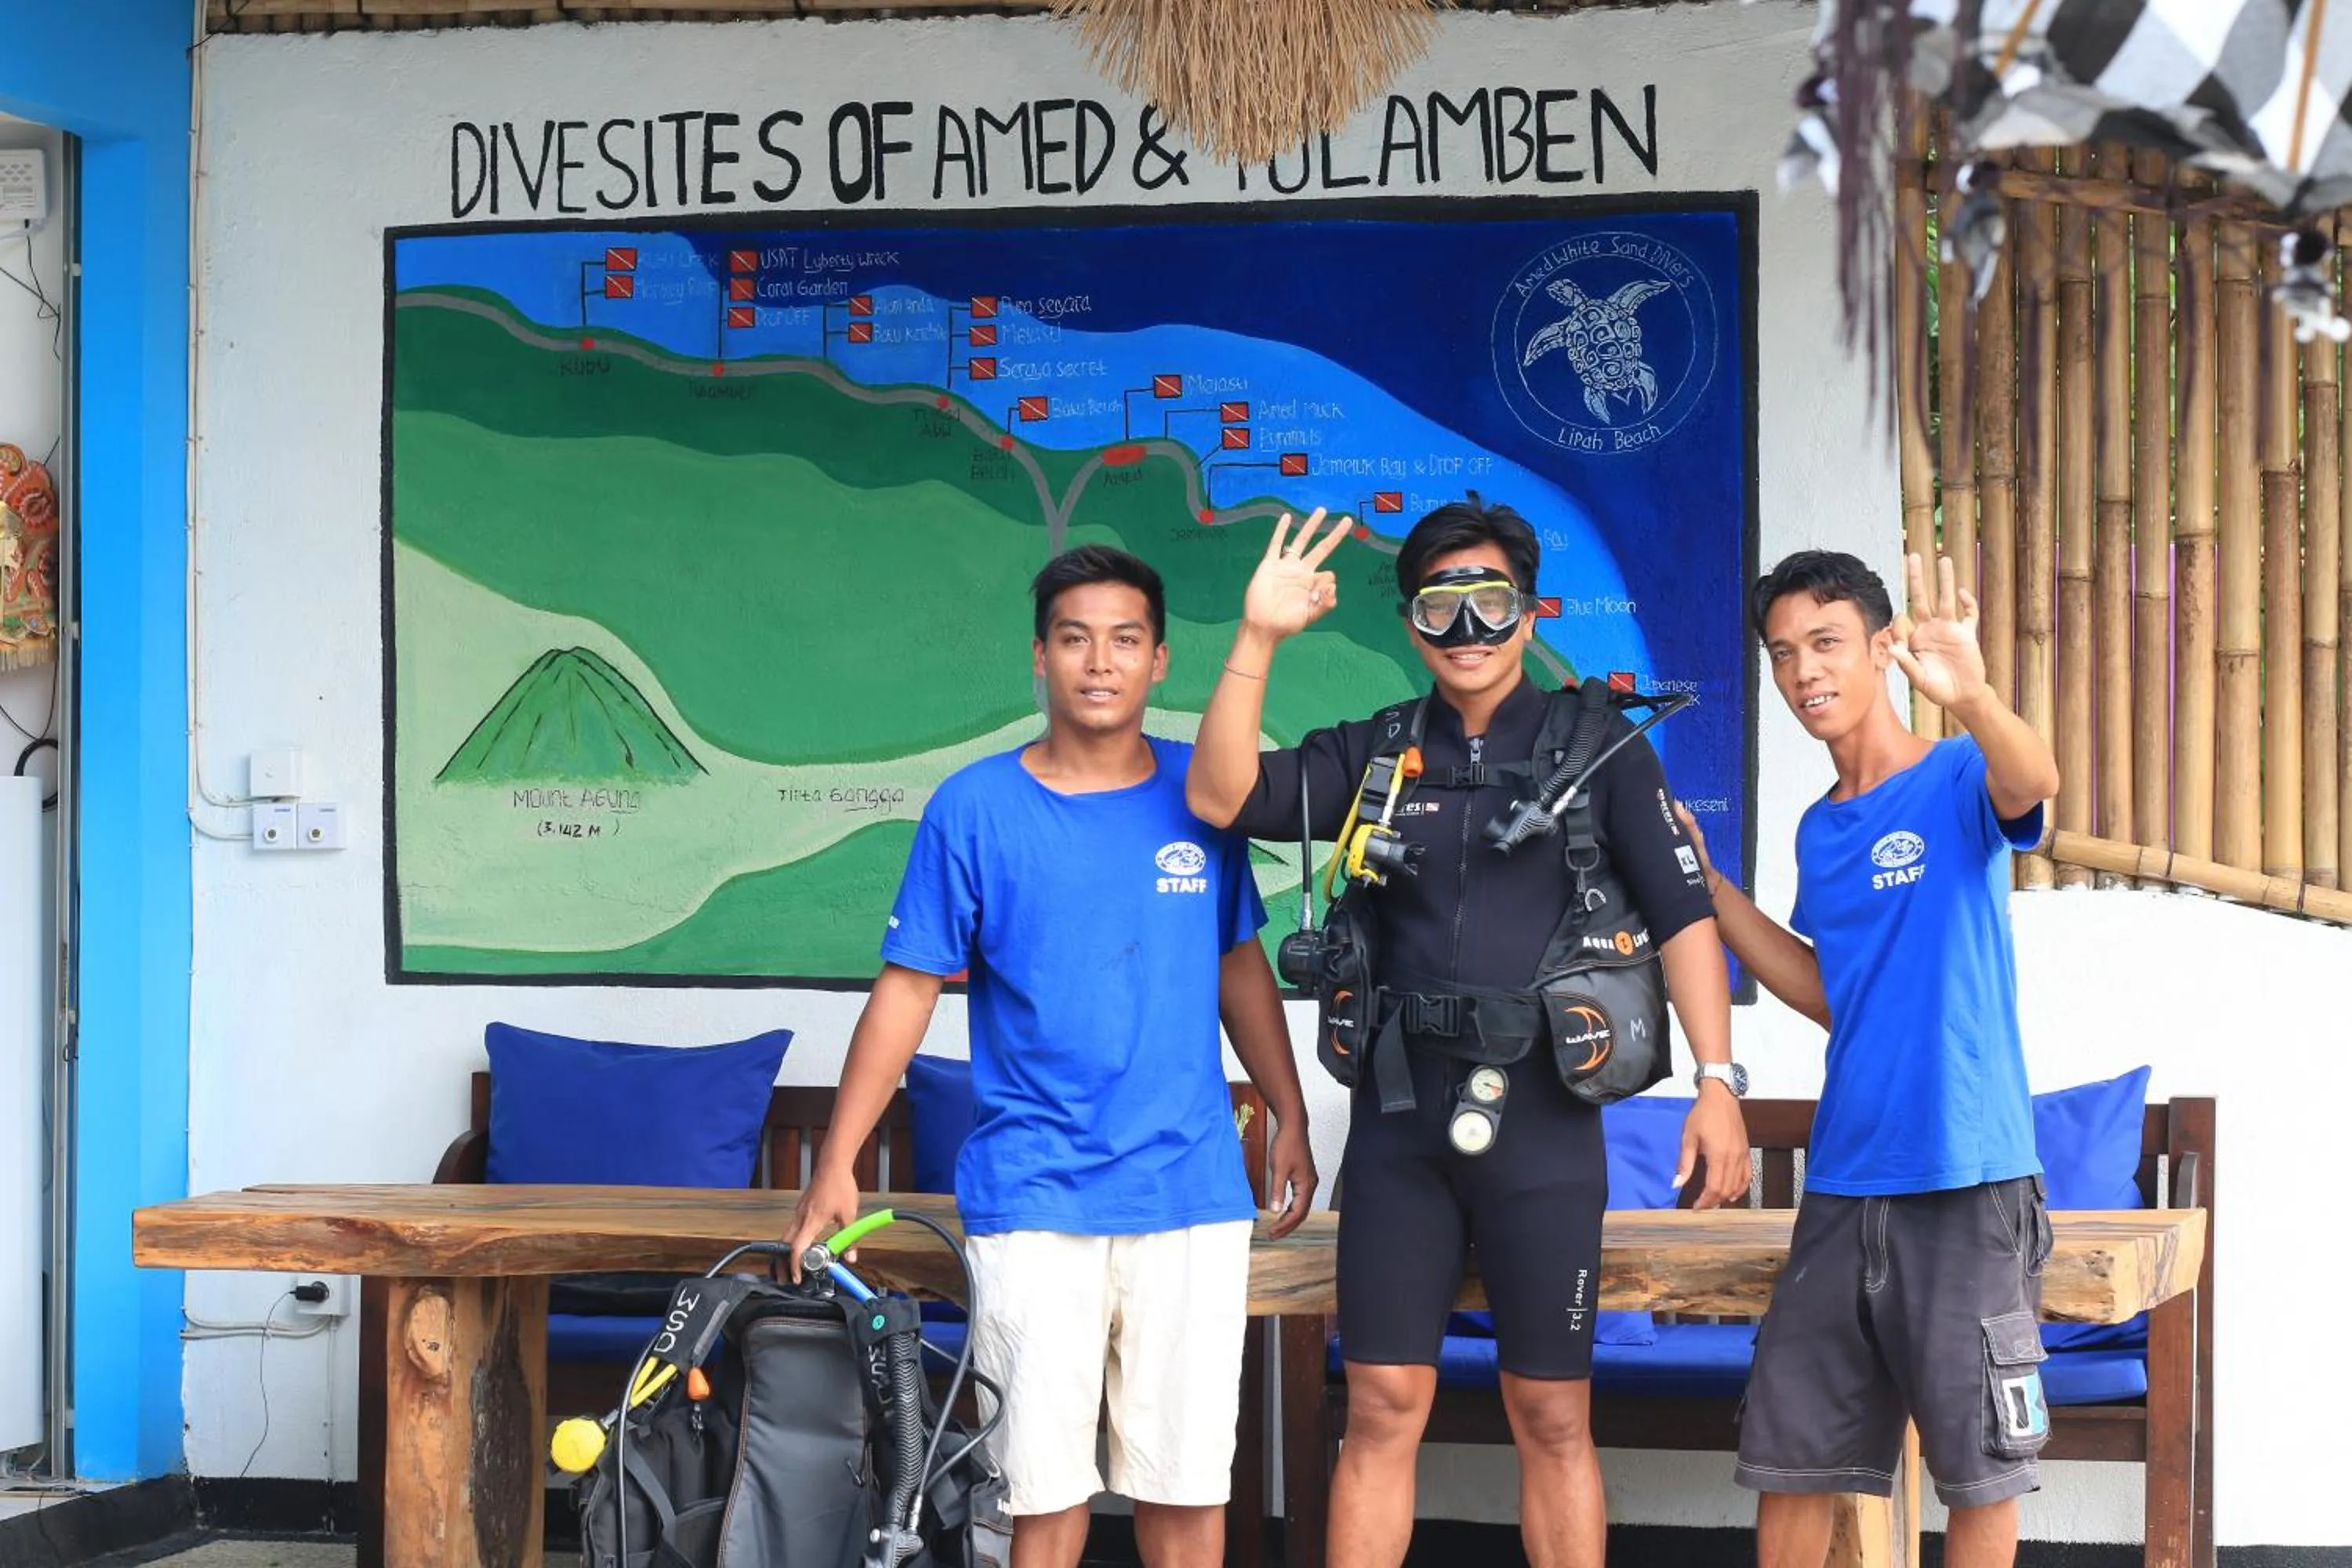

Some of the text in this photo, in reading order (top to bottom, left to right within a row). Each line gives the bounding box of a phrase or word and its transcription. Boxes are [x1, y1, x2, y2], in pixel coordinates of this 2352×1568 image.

[829, 101, 913, 205] OF
[932, 100, 1116, 200] AMED
[1131, 105, 1189, 189] &
[1236, 84, 1658, 194] ULAMBEN
[1555, 238, 1600, 265] White
[1611, 235, 1649, 259] Sand
[757, 277, 848, 299] Coral Garden
[1614, 423, 1661, 450] Beach
[1413, 458, 1425, 475] &
[1595, 595, 1637, 615] Moon
[1156, 877, 1207, 893] STAFF
[1630, 1018, 1646, 1043] M
[1574, 1269, 1588, 1307] Rover
[653, 1286, 701, 1353] WSD
